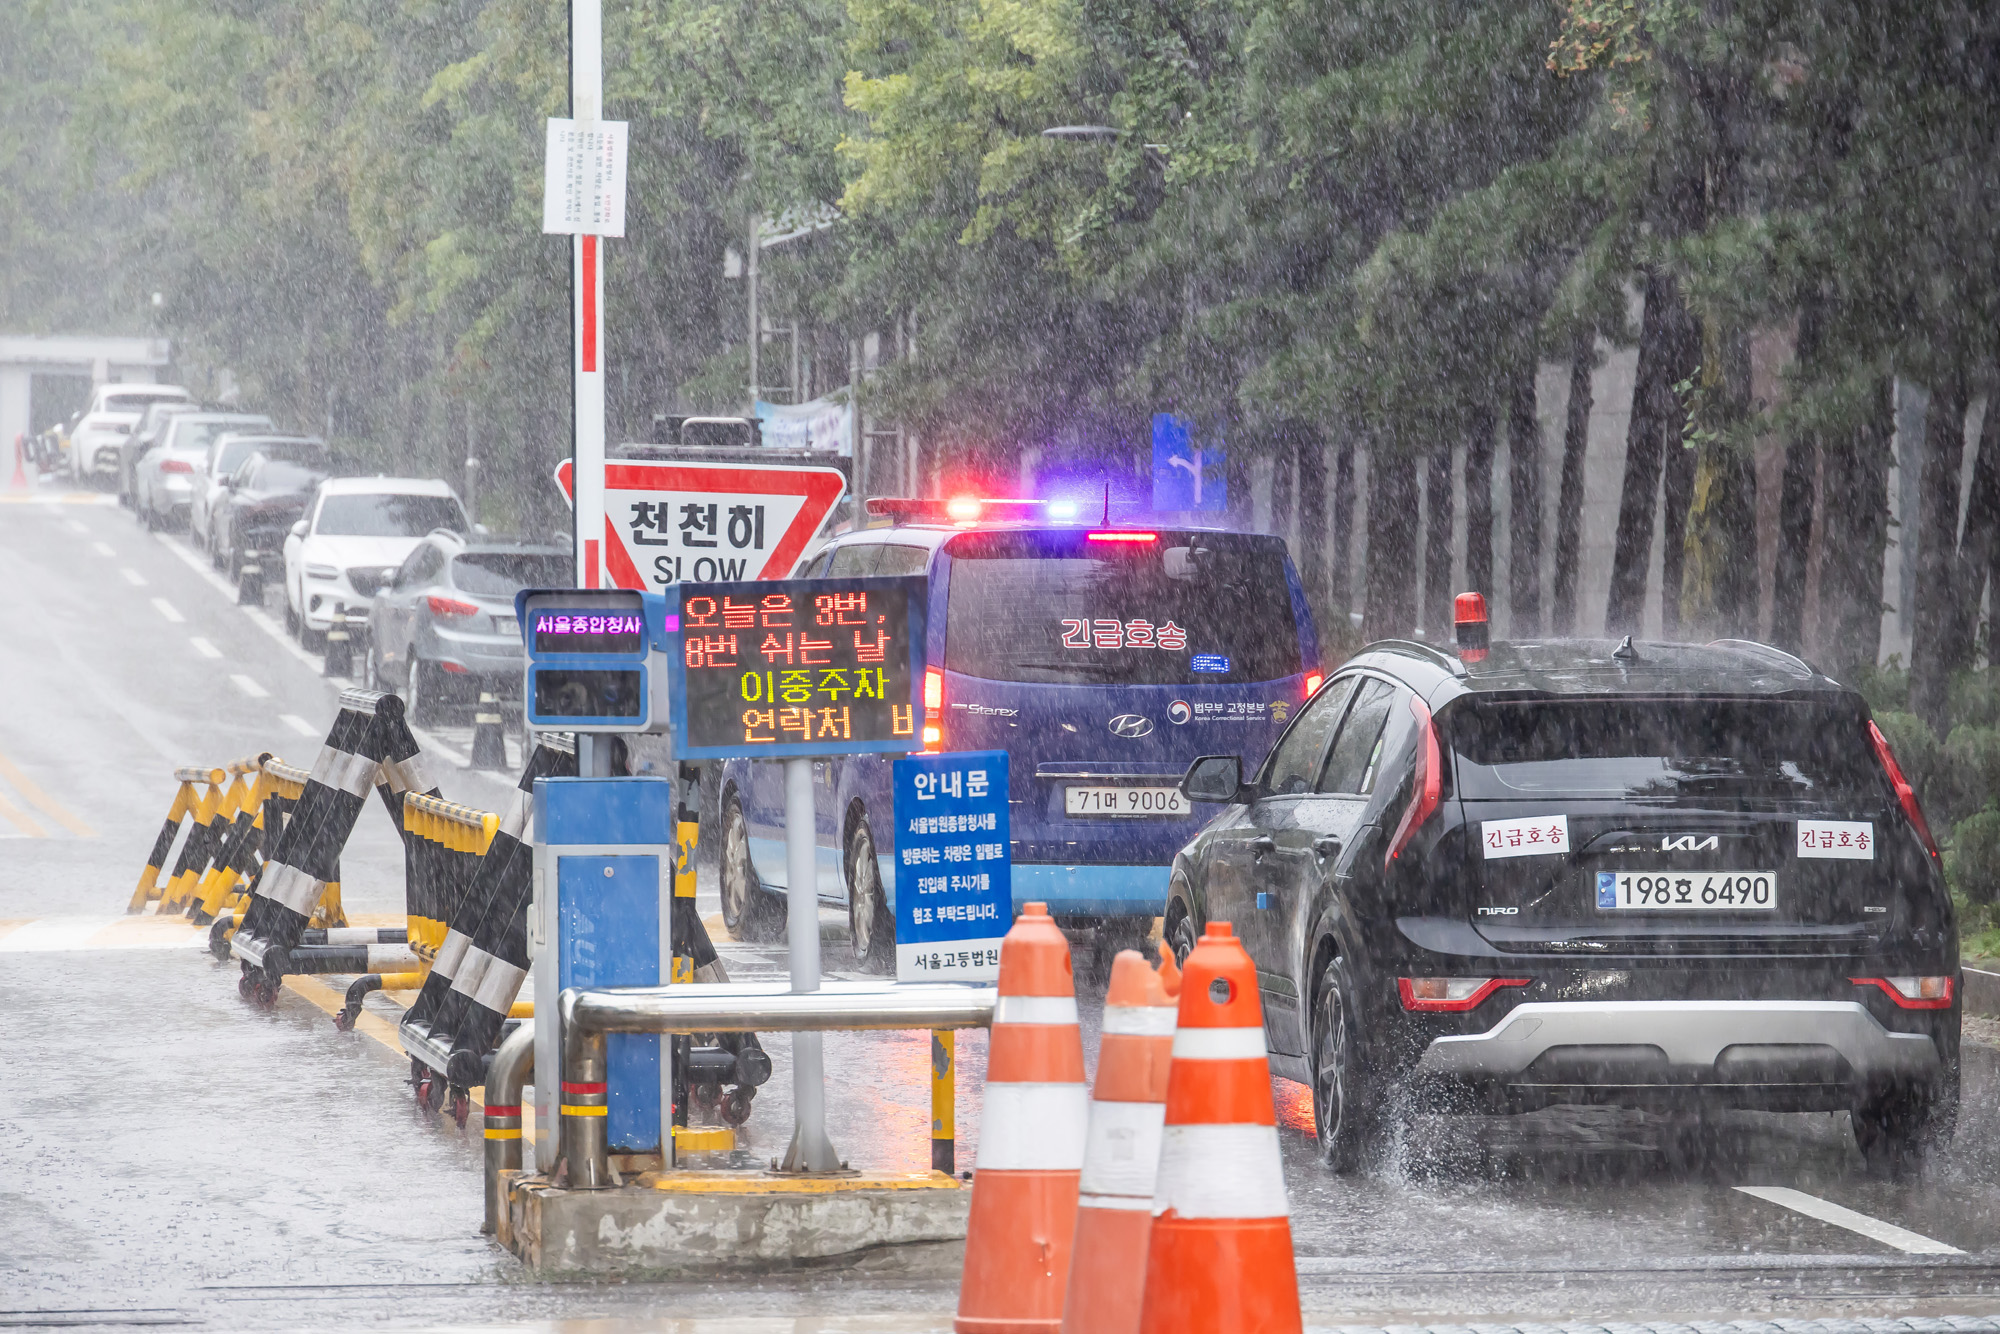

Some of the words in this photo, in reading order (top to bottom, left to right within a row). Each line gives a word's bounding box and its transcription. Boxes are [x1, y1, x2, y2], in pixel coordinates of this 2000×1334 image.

[629, 502, 764, 549] 천천히
[653, 556, 747, 584] SLOW
[685, 594, 794, 628] 오늘은
[815, 592, 886, 626] 3번,
[536, 615, 642, 634] 서울종합청사
[1061, 618, 1187, 650] 긴급호송
[685, 634, 737, 668] 8번
[760, 632, 833, 664] 쉬는
[854, 630, 891, 662] 날
[741, 668, 890, 703] 이중주차
[968, 704, 1019, 717] Starex
[1194, 702, 1224, 714] 법무부
[1227, 702, 1265, 714] 교정본부
[742, 706, 851, 742] 연락처
[914, 770, 989, 800] 안내문
[1078, 791, 1117, 810] 71머
[1128, 791, 1180, 811] 9006
[908, 813, 997, 835] 서울법원종합청사를
[1486, 824, 1565, 849] 긴급호송
[1662, 835, 1719, 851] KIA
[1800, 829, 1871, 851] 긴급호송
[902, 847, 940, 865] 방문하는
[944, 845, 972, 863] 차량은
[975, 843, 1004, 860] 일렬로
[917, 876, 948, 894] 진입해
[950, 874, 990, 892] 주시기를
[1621, 876, 1692, 905] 198호
[1701, 876, 1770, 905] 6490
[912, 907, 933, 925] 협조
[936, 903, 999, 923] 부탁드립니다.
[914, 949, 998, 970] 서울고등법원
